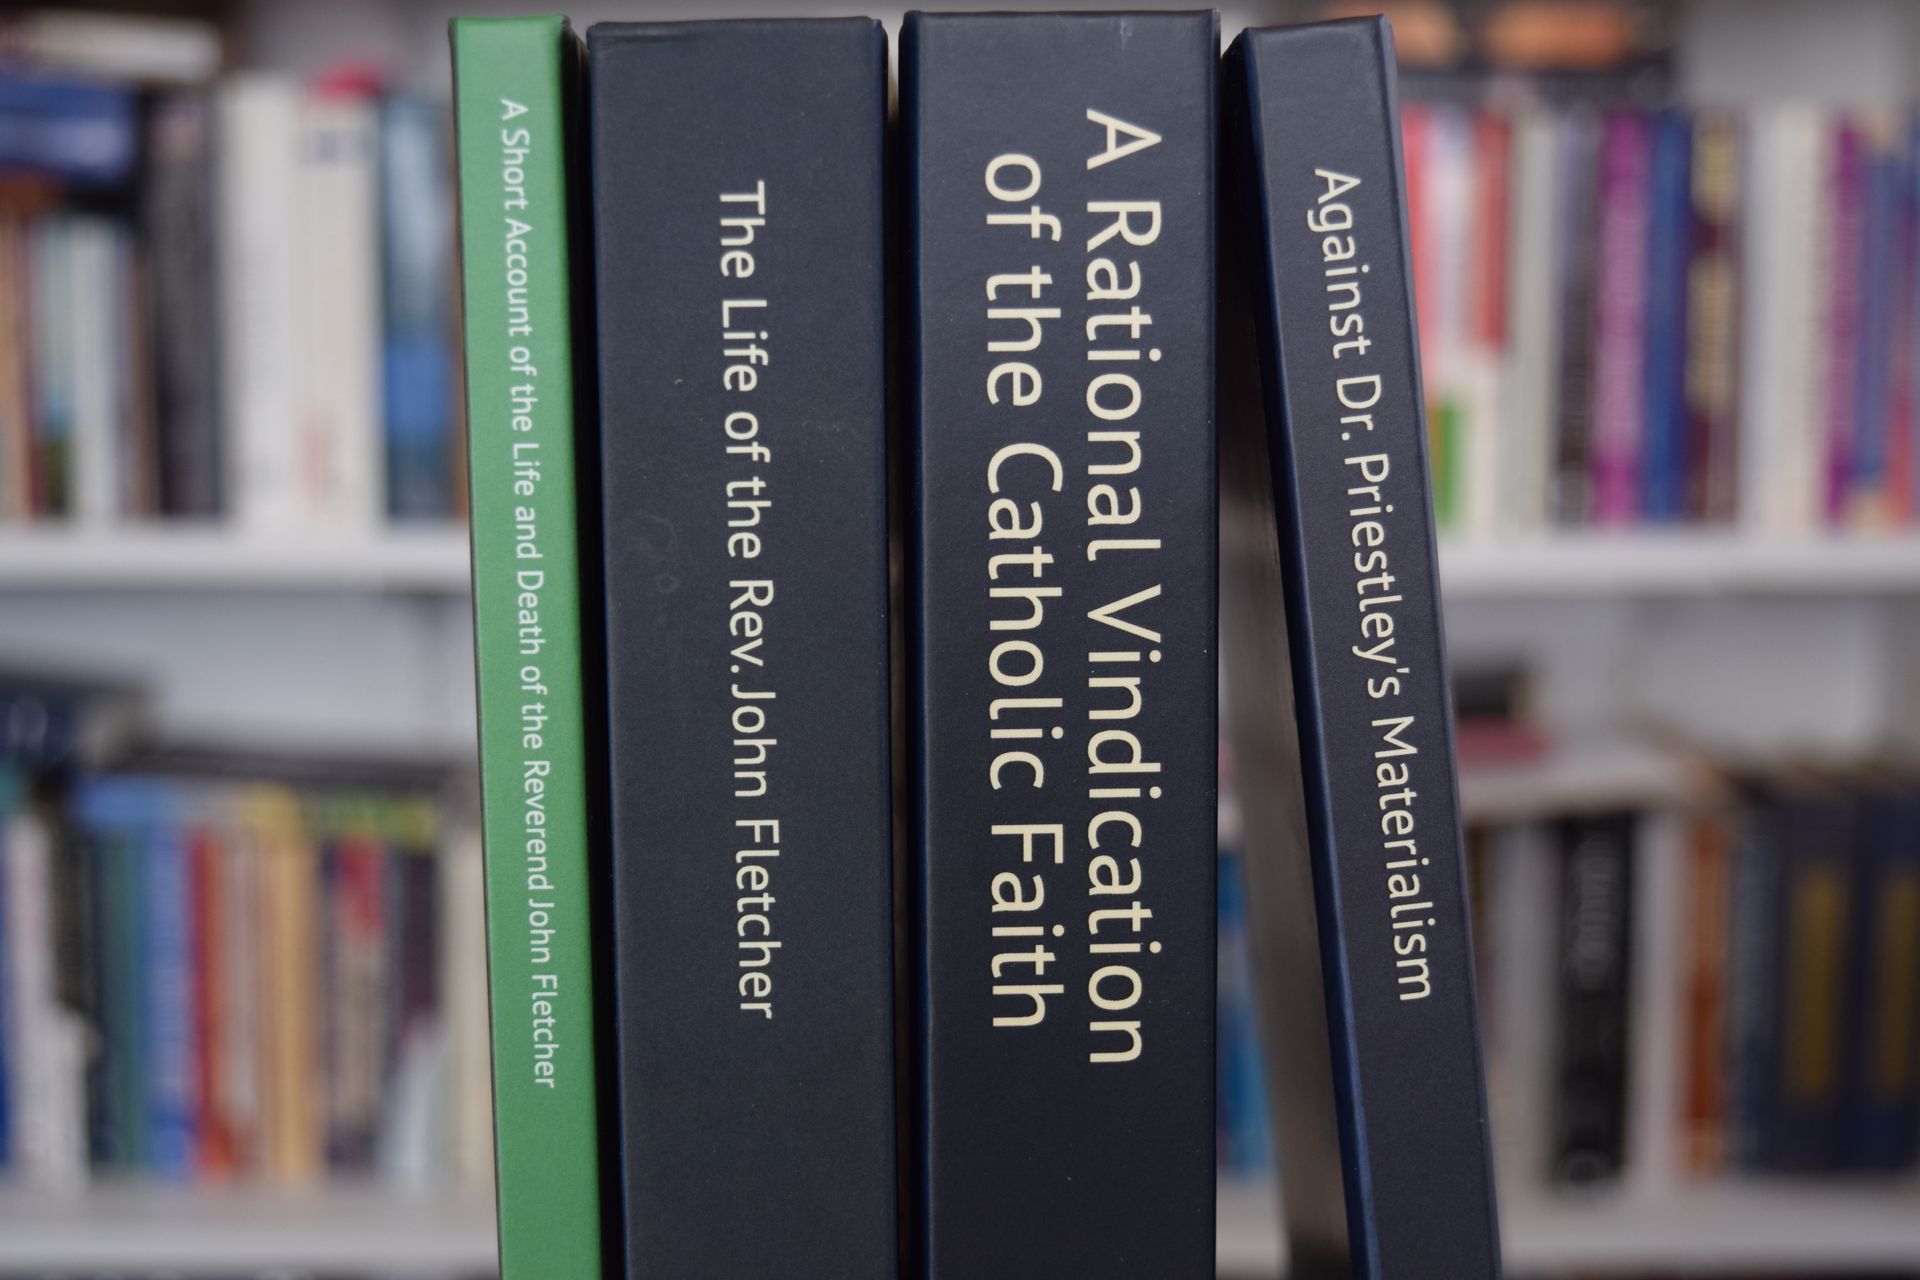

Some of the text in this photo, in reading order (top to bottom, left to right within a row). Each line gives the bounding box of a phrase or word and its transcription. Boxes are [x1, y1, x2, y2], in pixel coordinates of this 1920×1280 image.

[501, 98, 560, 1088] A Short Account of the Life and Death of the Reverend John Fletcher
[719, 180, 782, 1019] The Life of the Rev. John Fletcher
[985, 152, 1064, 1026] of the Catholic Faith
[1086, 107, 1162, 1062] A Rational Vindication
[1307, 167, 1435, 1000] Against Dr. Priestley's Materialism
